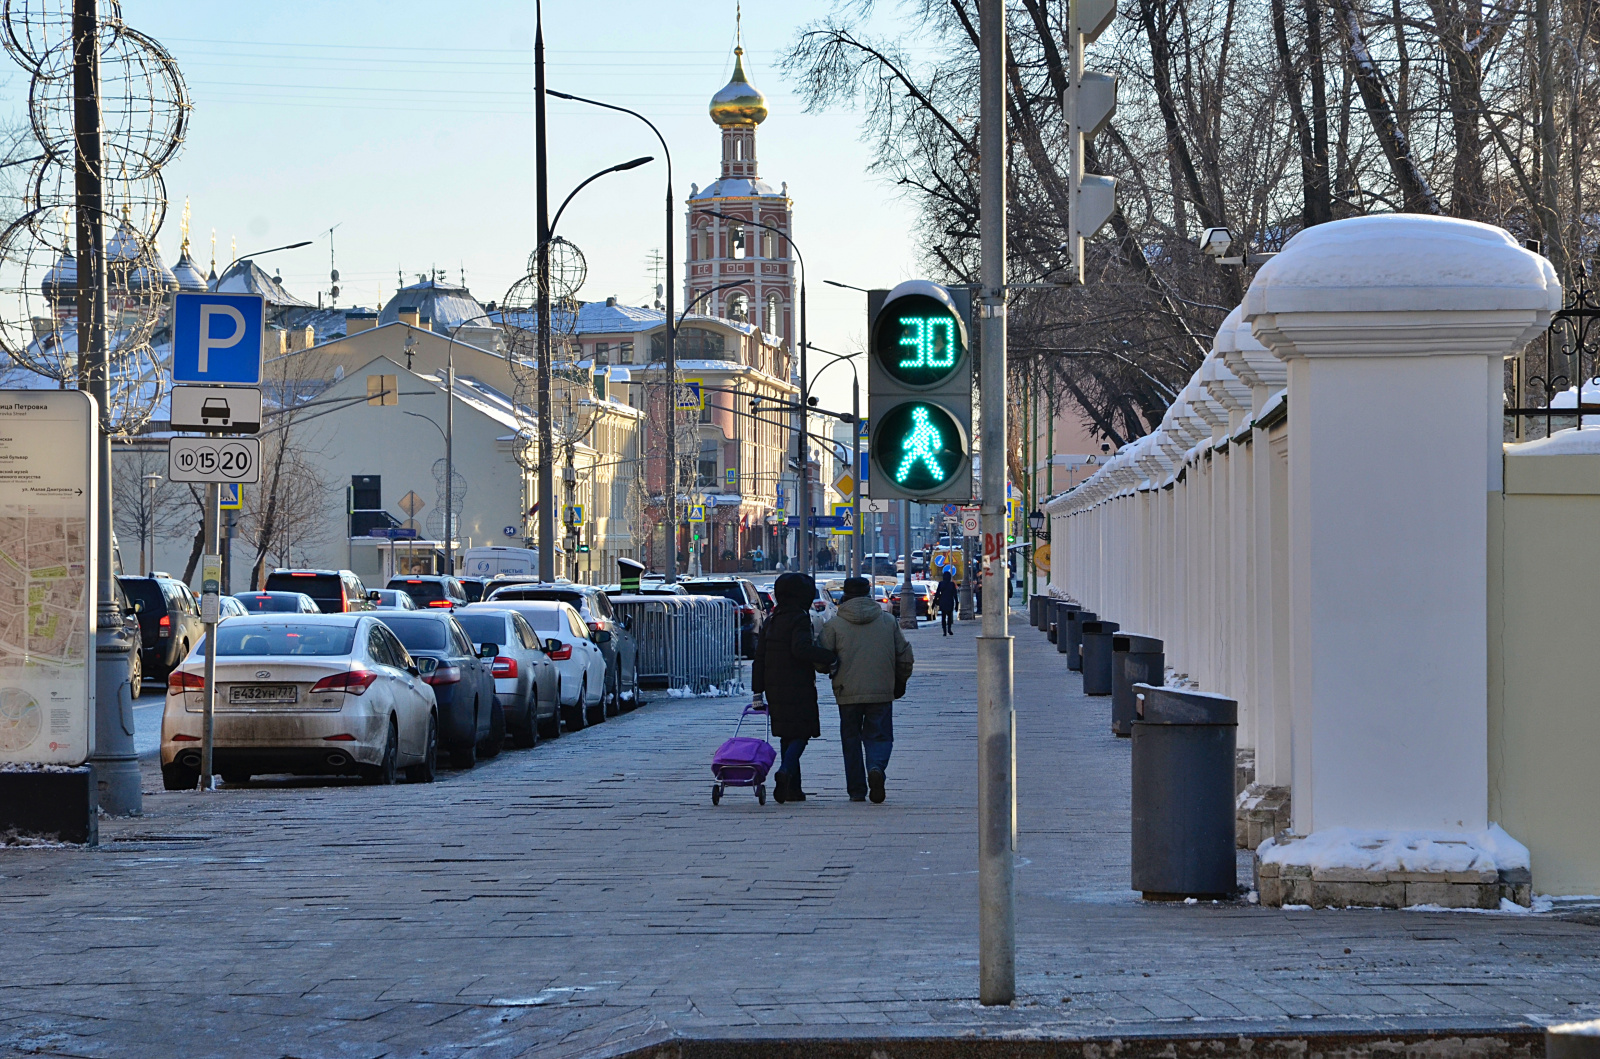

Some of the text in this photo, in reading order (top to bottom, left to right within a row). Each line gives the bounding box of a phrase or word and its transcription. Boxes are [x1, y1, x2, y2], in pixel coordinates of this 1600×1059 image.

[198, 304, 246, 372] P
[898, 316, 954, 368] 30
[14, 403, 48, 411] Петровка
[180, 451, 248, 470] 10 15 20
